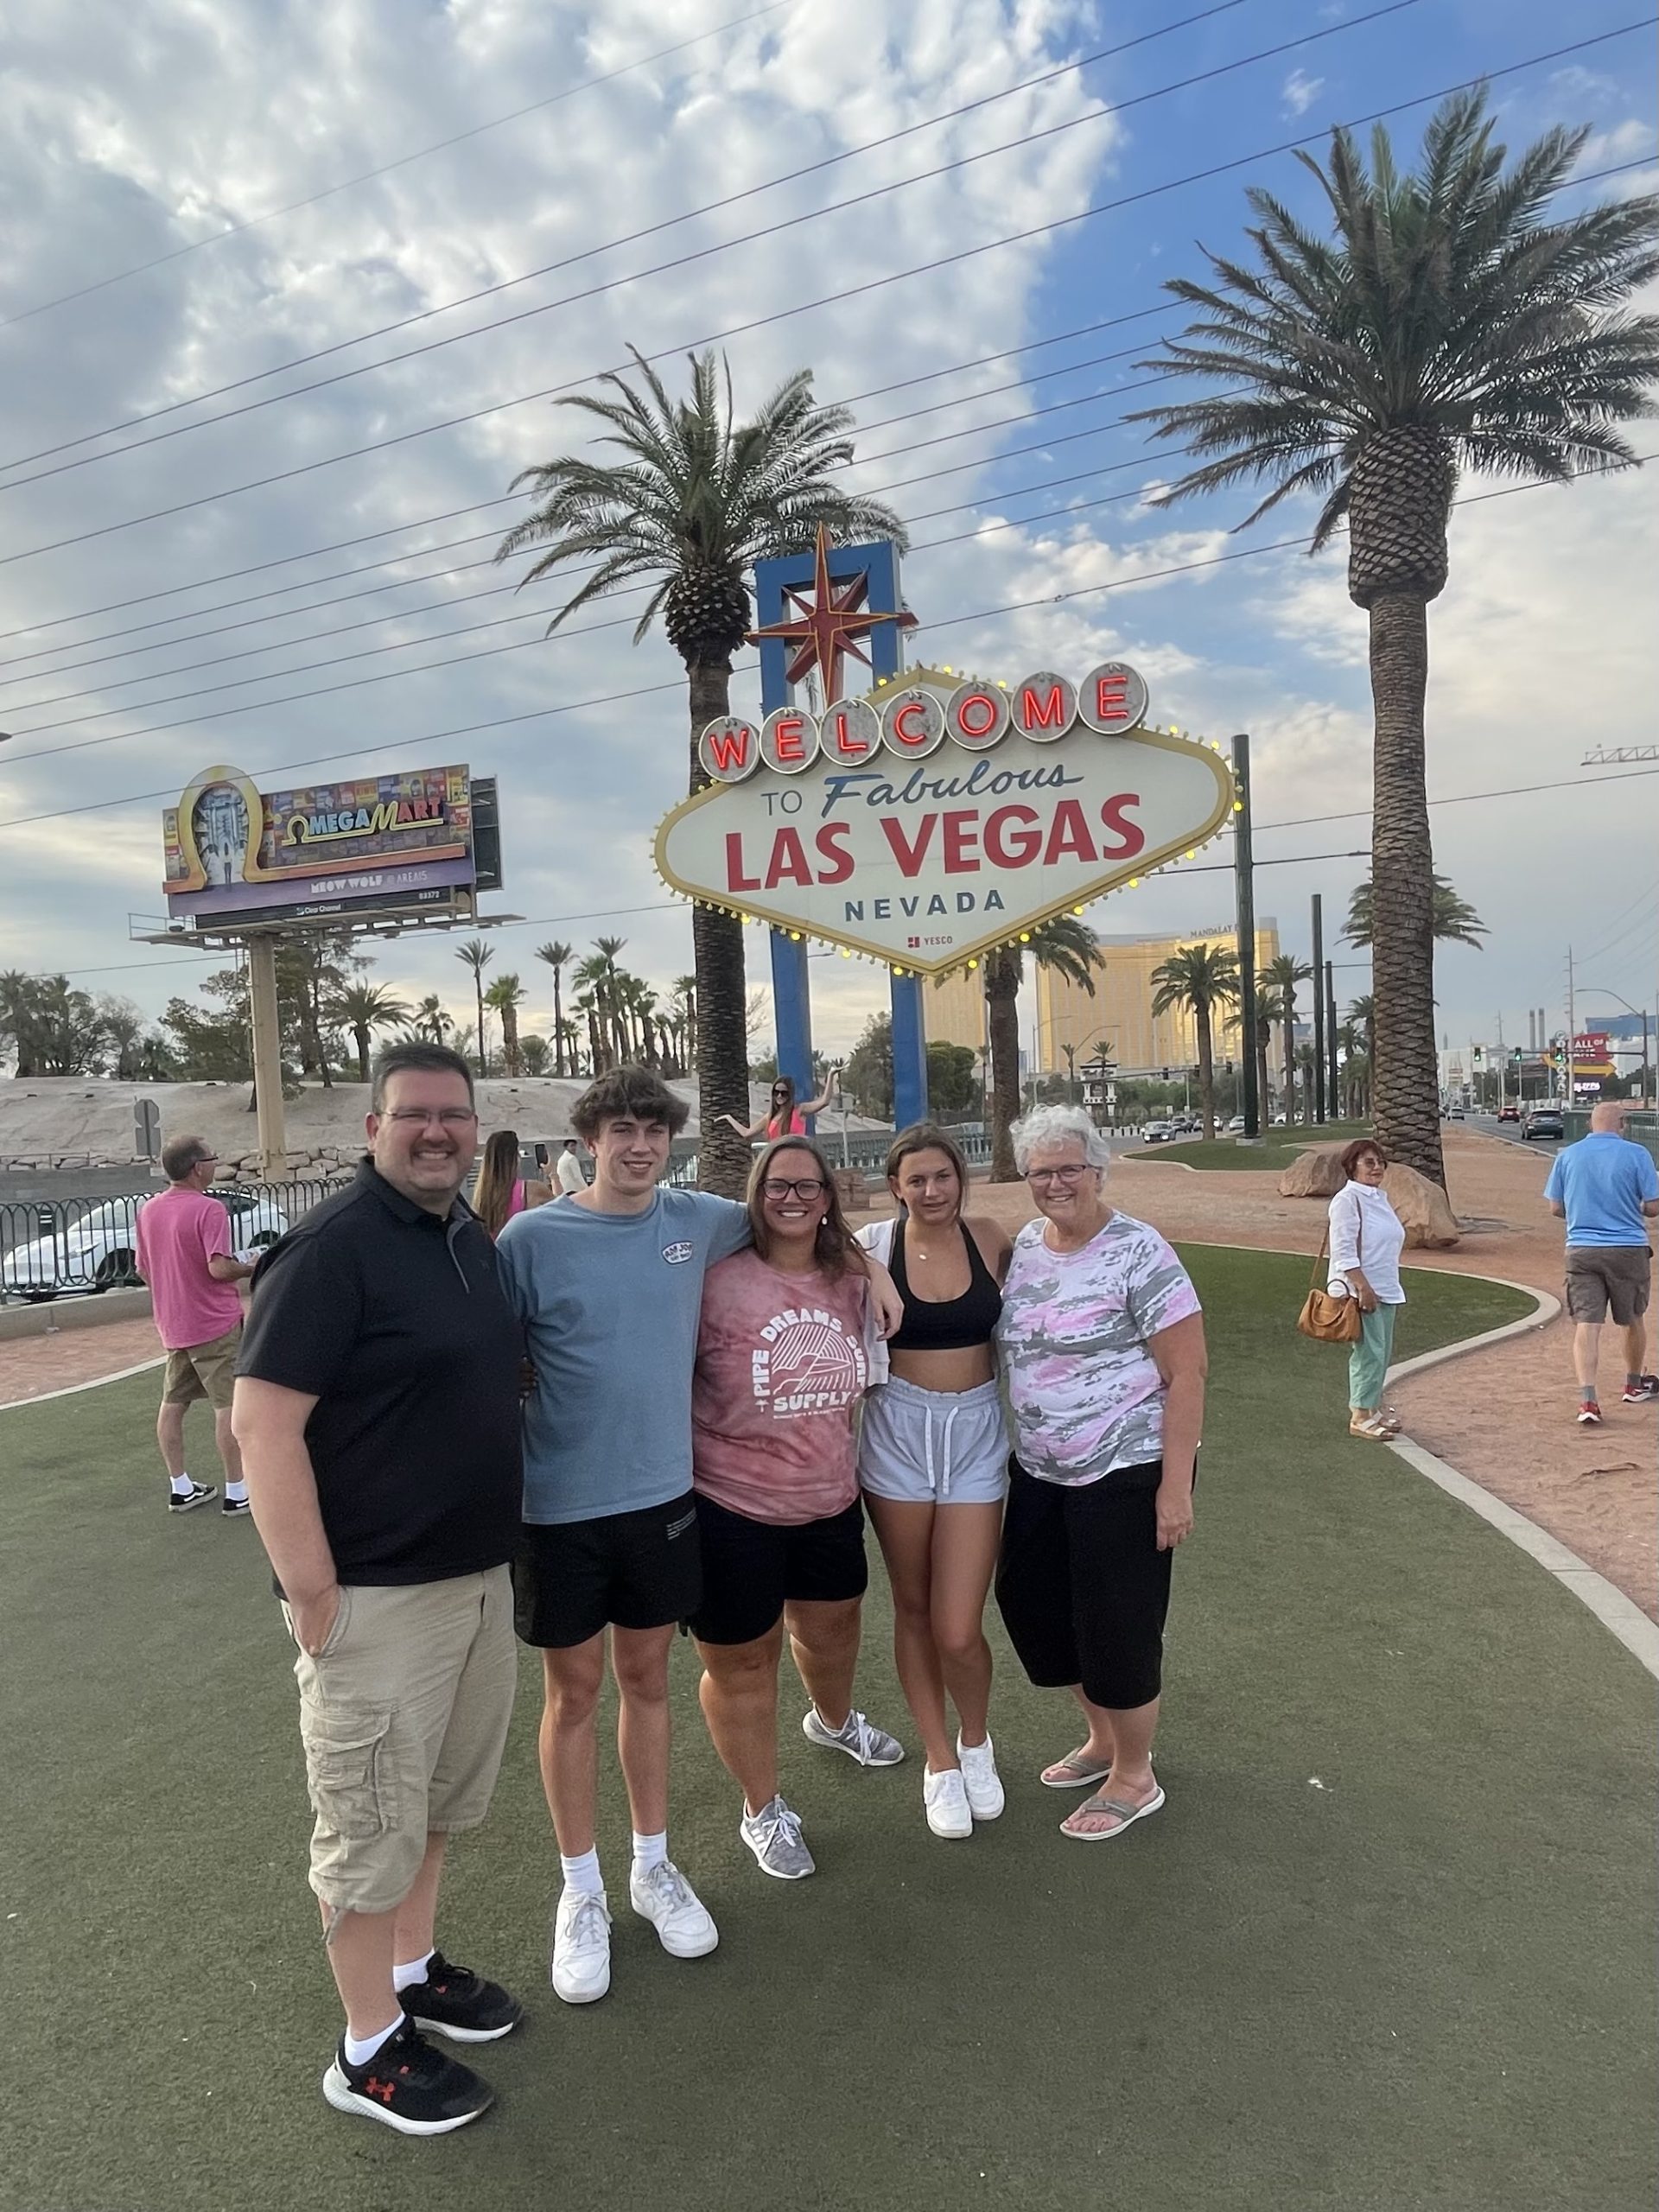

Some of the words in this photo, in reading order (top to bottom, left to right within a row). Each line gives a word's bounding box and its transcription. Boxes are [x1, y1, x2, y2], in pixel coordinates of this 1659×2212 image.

[710, 675, 1129, 771] WELCOME
[760, 790, 804, 817] TO
[820, 760, 1084, 818] Fabulous
[725, 822, 855, 893] LAS
[879, 793, 1145, 878] VEGAS
[311, 880, 346, 893] MEOW
[347, 874, 383, 888] WOLF
[844, 889, 1005, 922] NEVADA
[924, 936, 953, 945] YESCO
[1190, 925, 1232, 938] MANDALAY
[1573, 1039, 1593, 1048] ALL
[760, 1307, 842, 1343] DREAMS
[752, 1349, 771, 1397] PIPE
[773, 1391, 852, 1412] SUPPLY
